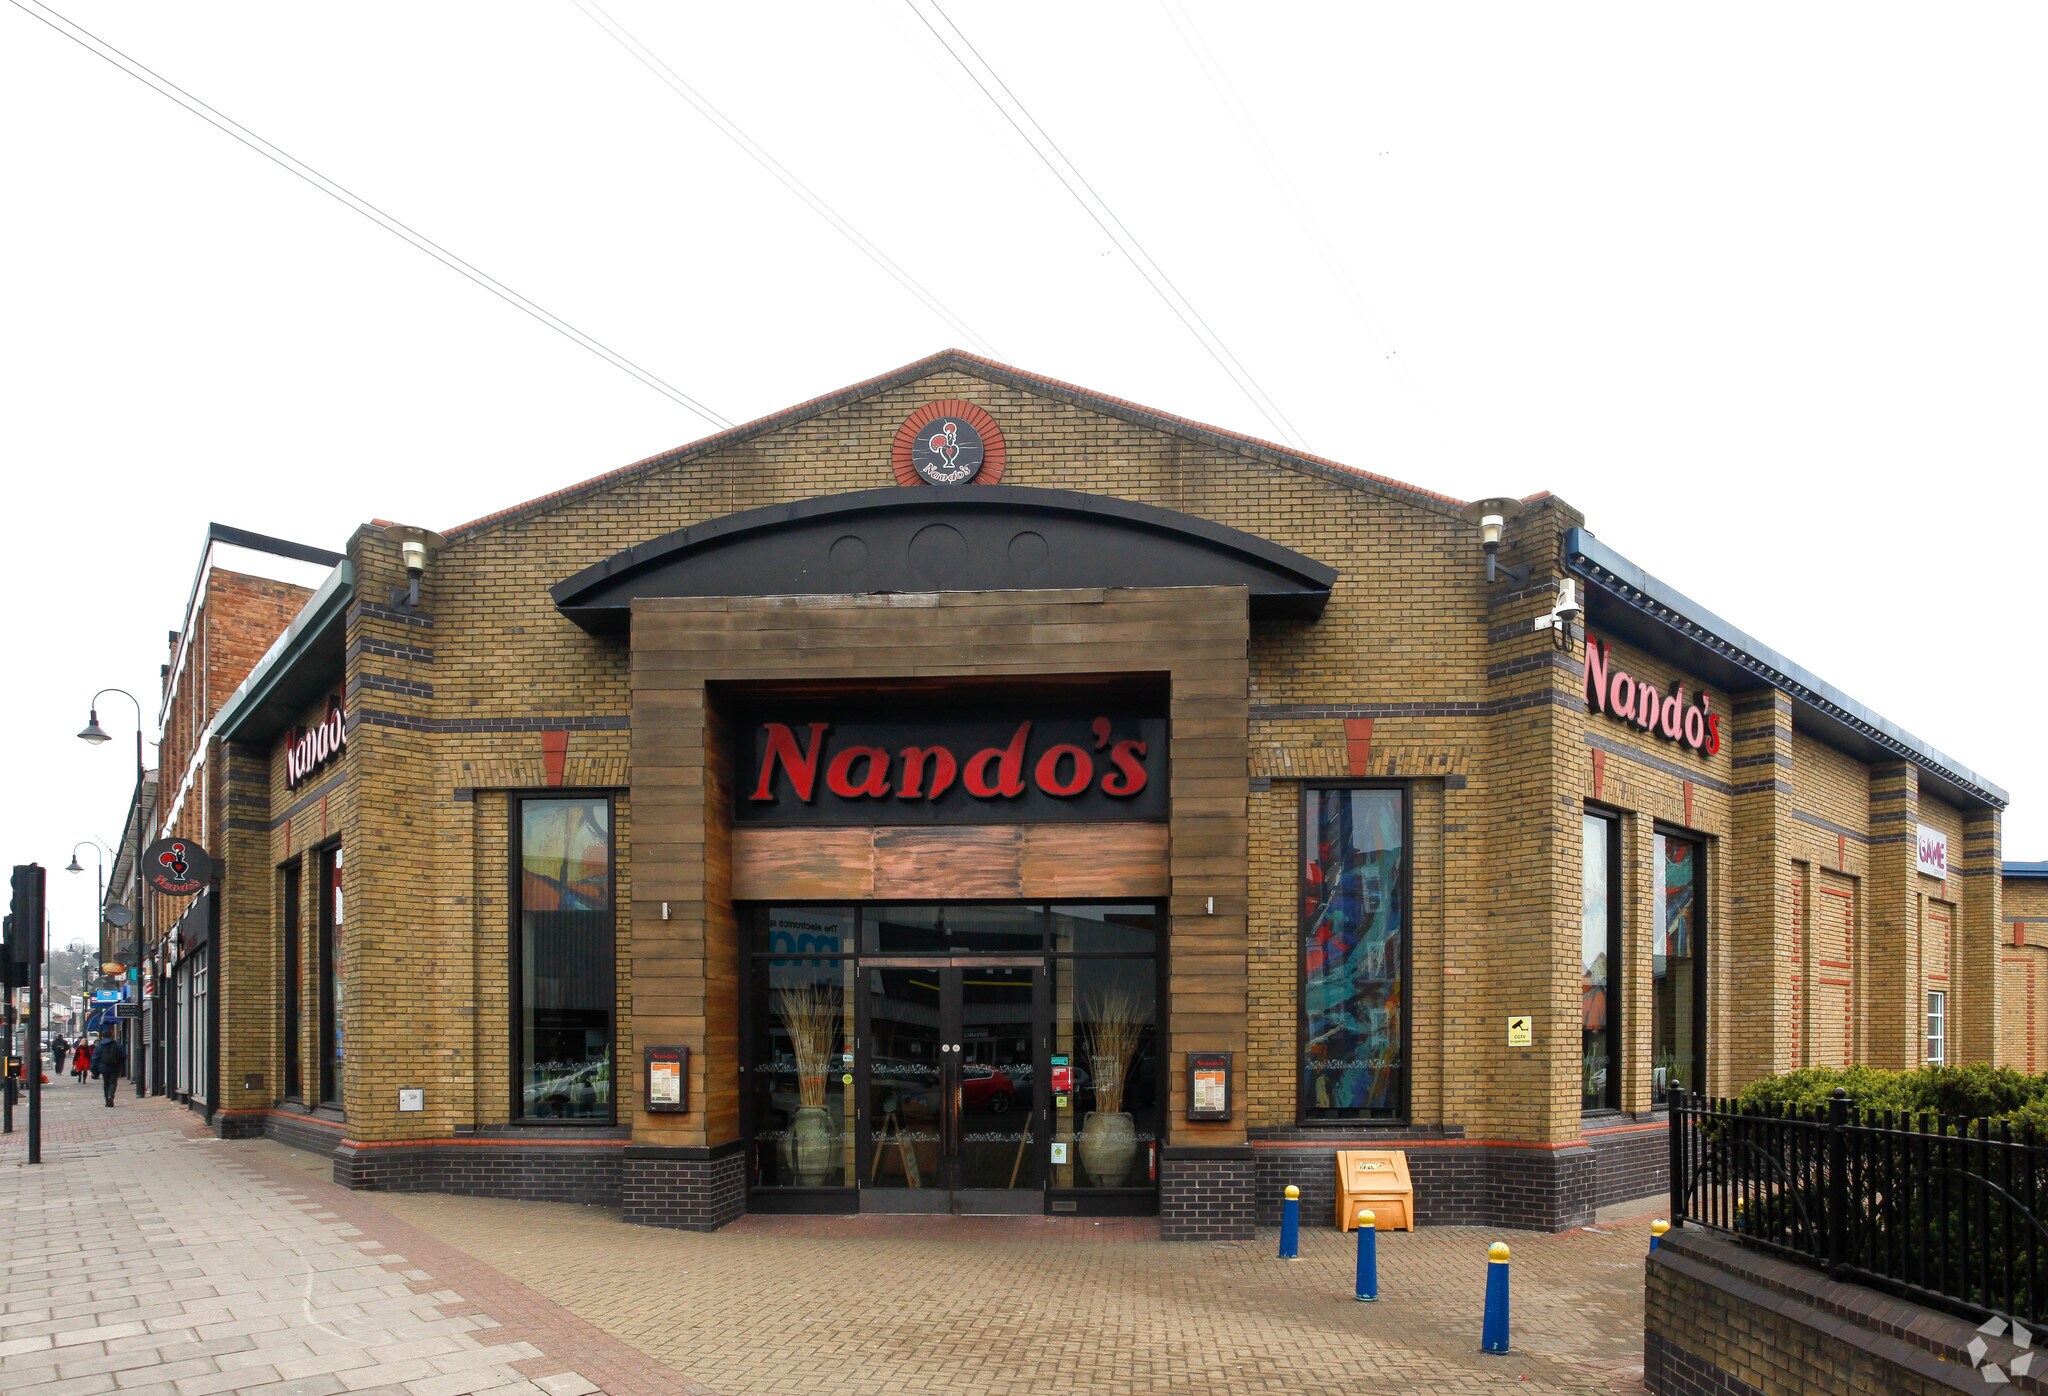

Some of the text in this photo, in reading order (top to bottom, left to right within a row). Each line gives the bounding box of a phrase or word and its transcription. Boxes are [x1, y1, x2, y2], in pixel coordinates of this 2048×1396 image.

[922, 462, 971, 482] Nando's
[1584, 632, 1721, 756] Nando's
[748, 716, 1150, 803] Nando's
[1919, 836, 1945, 869] GAME
[154, 875, 201, 892] Nando's
